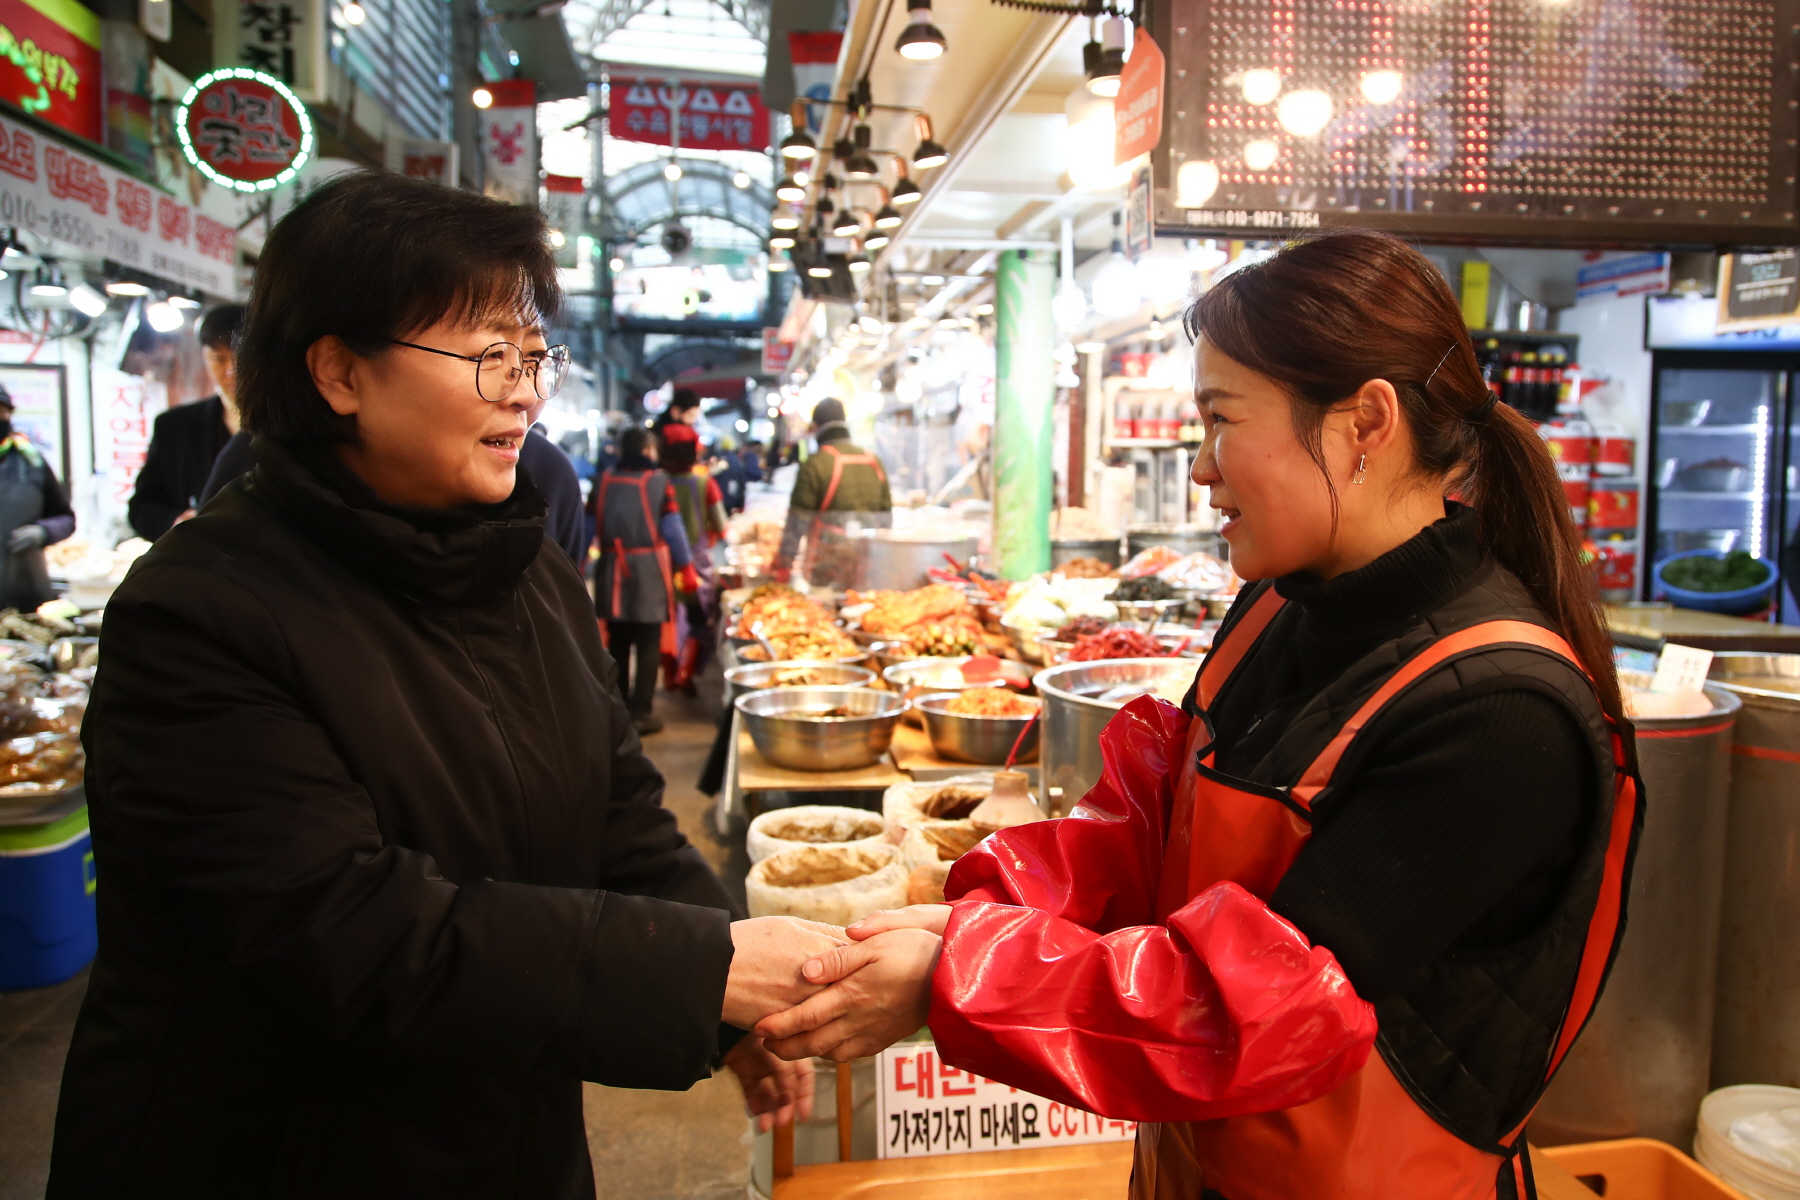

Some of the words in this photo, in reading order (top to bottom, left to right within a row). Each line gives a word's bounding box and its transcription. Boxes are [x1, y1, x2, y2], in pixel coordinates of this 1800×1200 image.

[44, 144, 110, 216] 만드는
[115, 178, 151, 233] 전통
[890, 1105, 972, 1154] 가져가지
[980, 1102, 1041, 1147] 마세요
